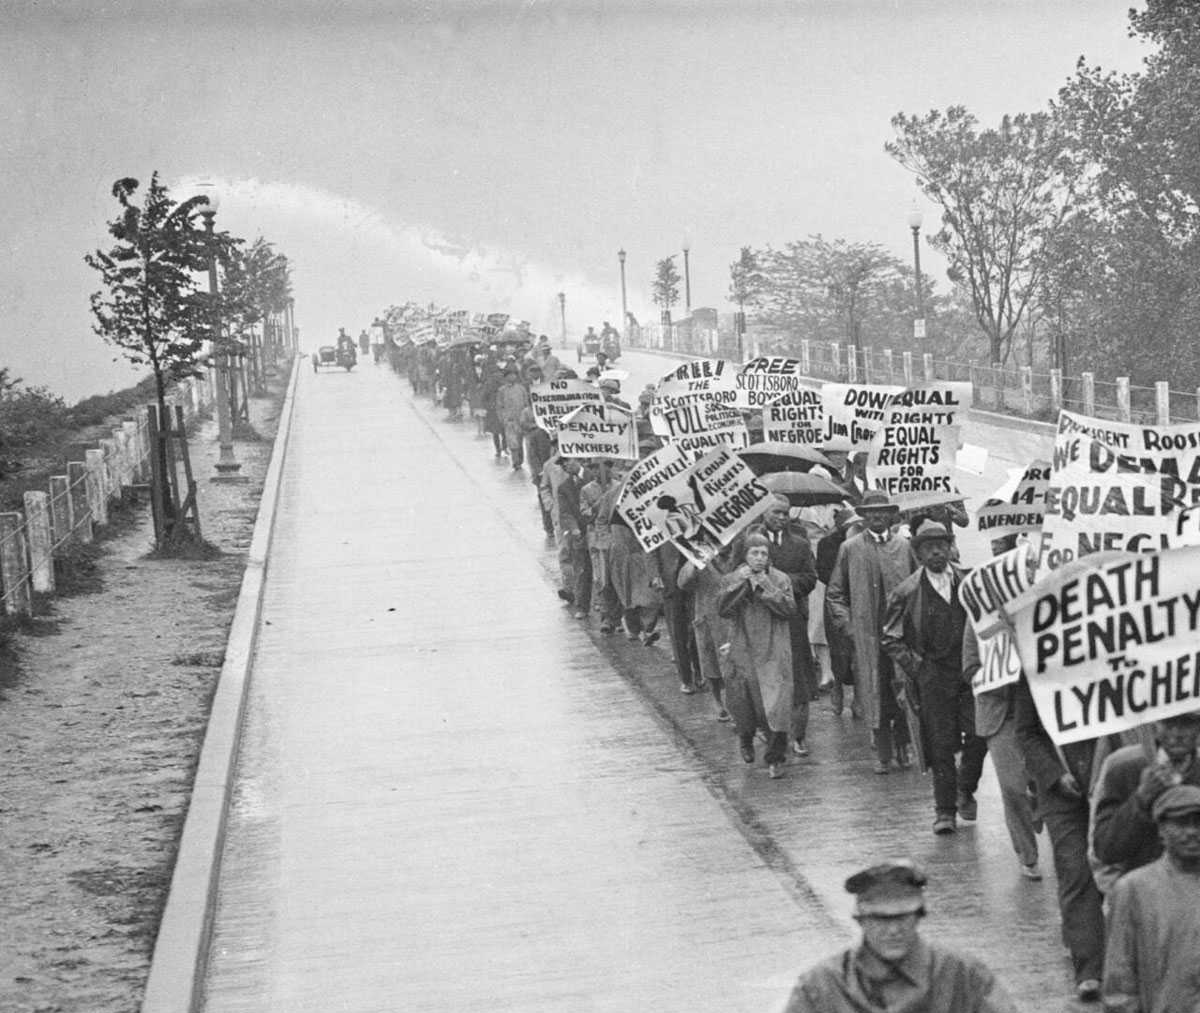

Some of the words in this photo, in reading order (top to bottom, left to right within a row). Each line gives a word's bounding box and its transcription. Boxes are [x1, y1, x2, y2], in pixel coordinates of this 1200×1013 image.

[743, 357, 800, 374] FREE
[550, 381, 568, 390] NO
[688, 380, 710, 391] THE
[736, 374, 799, 392] SCOTTSBORO
[560, 422, 627, 436] PENALTY
[665, 404, 708, 437] FULL
[673, 431, 735, 451] QUALITY
[768, 428, 823, 444] NEGROE
[884, 426, 941, 447] EQUAL
[561, 443, 620, 455] LYNCHERS
[877, 446, 940, 466] RIGHTS
[1052, 439, 1081, 473] WE
[900, 466, 924, 477] FOR
[874, 476, 951, 497] NEGROES
[705, 478, 769, 534] NEGROES
[1046, 485, 1156, 522] EQUAL
[1032, 556, 1160, 633] DEATH
